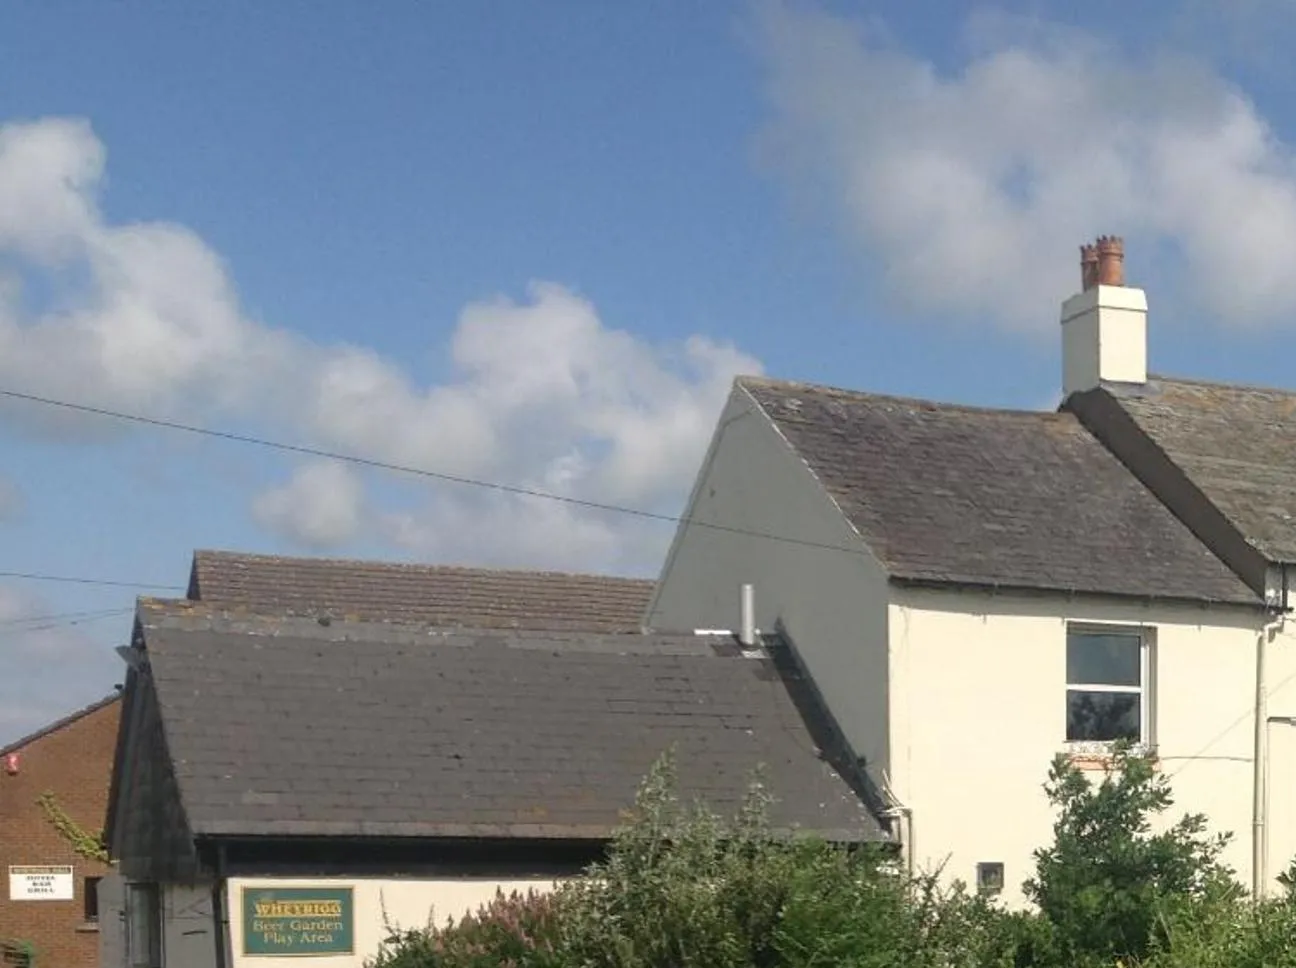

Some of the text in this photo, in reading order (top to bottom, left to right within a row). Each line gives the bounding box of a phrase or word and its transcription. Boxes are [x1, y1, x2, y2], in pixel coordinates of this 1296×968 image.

[253, 919, 343, 931] Beer Garden
[263, 932, 333, 946] Play Area
